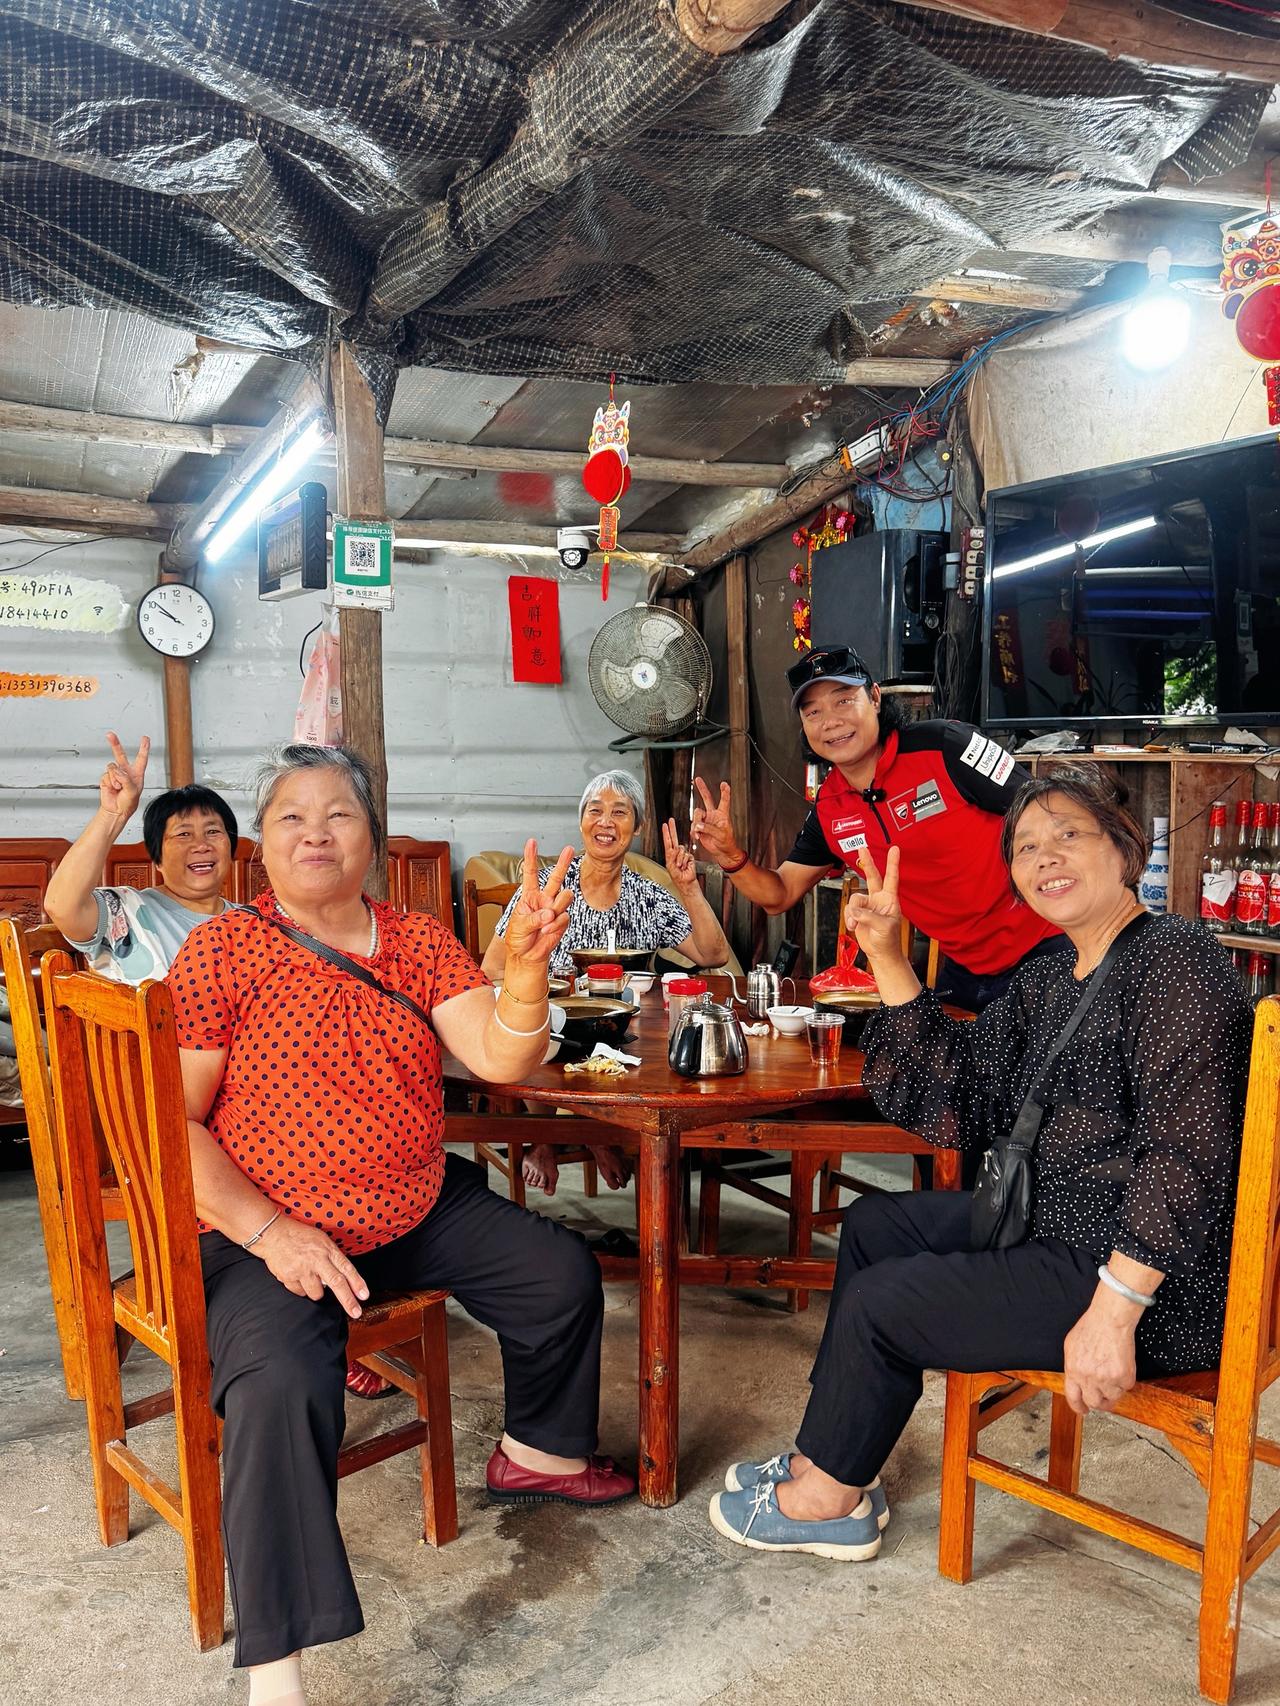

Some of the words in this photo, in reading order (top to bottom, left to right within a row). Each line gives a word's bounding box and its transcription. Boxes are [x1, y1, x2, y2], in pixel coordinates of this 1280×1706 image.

[148, 601, 156, 609] 10
[197, 605, 203, 613] 2
[202, 619, 207, 627] 3
[521, 584, 546, 666] 吉祥如意
[149, 627, 154, 635] 8
[157, 639, 163, 648] 7
[0, 680, 91, 693] :13531390368
[912, 793, 938, 808] Lenovo
[846, 837, 864, 848] riello
